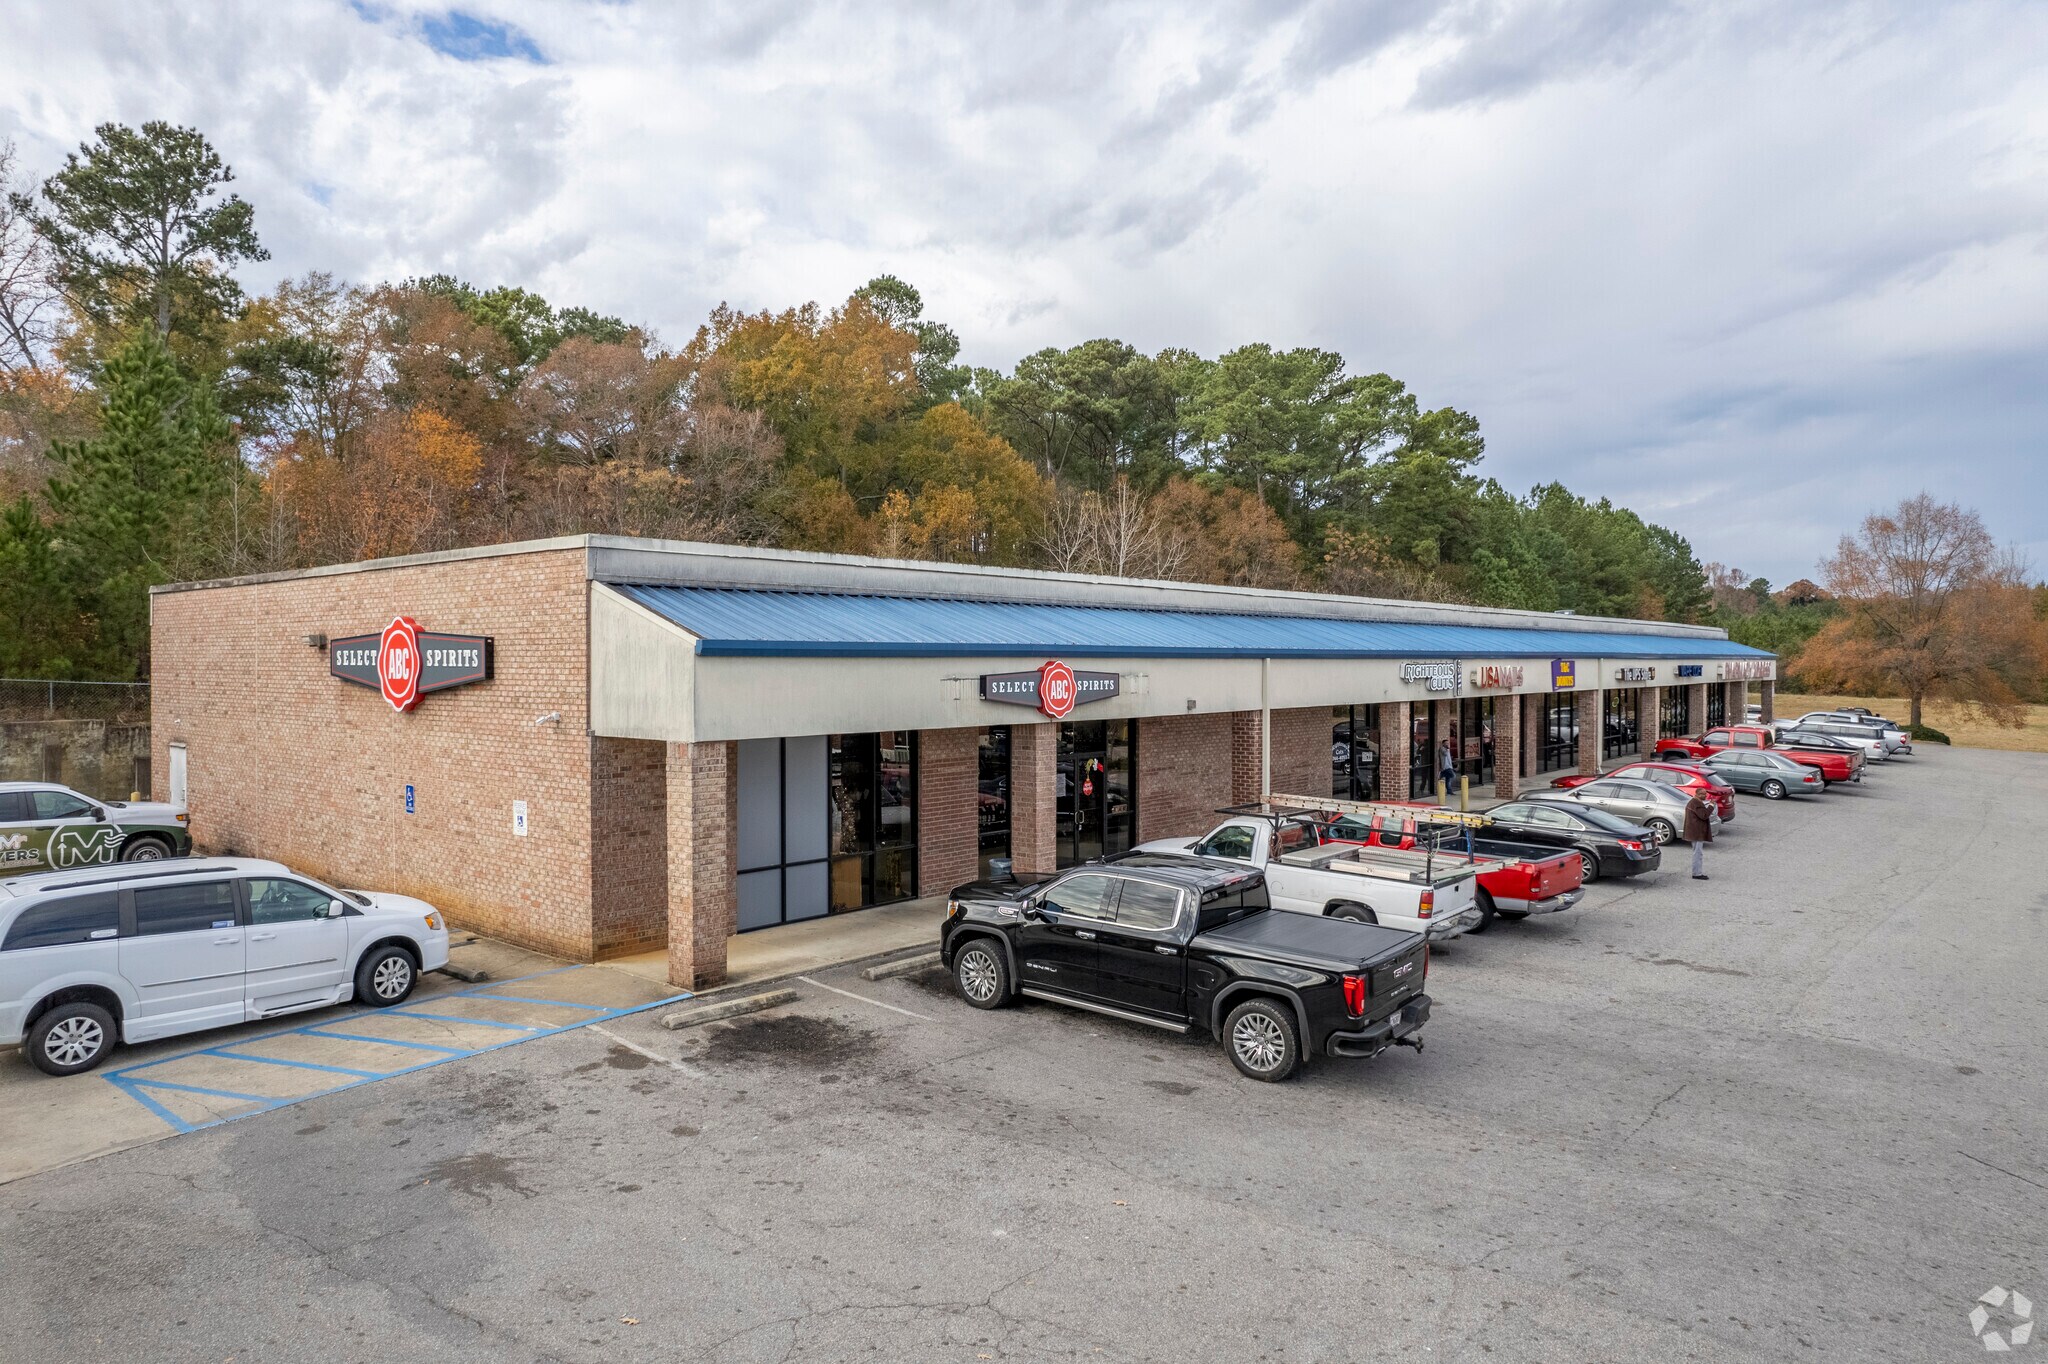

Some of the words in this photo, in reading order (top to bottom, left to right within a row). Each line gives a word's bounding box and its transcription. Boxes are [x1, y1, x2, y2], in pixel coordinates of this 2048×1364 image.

[336, 650, 378, 666] SELECT
[388, 648, 410, 681] ABC
[426, 649, 479, 668] SPIRITS
[1405, 664, 1455, 683] RIGHTEOUS
[992, 681, 1035, 693] SELECT
[1050, 679, 1069, 700] ABC
[1077, 679, 1115, 691] SPIRITS
[1430, 677, 1455, 691] CUTS
